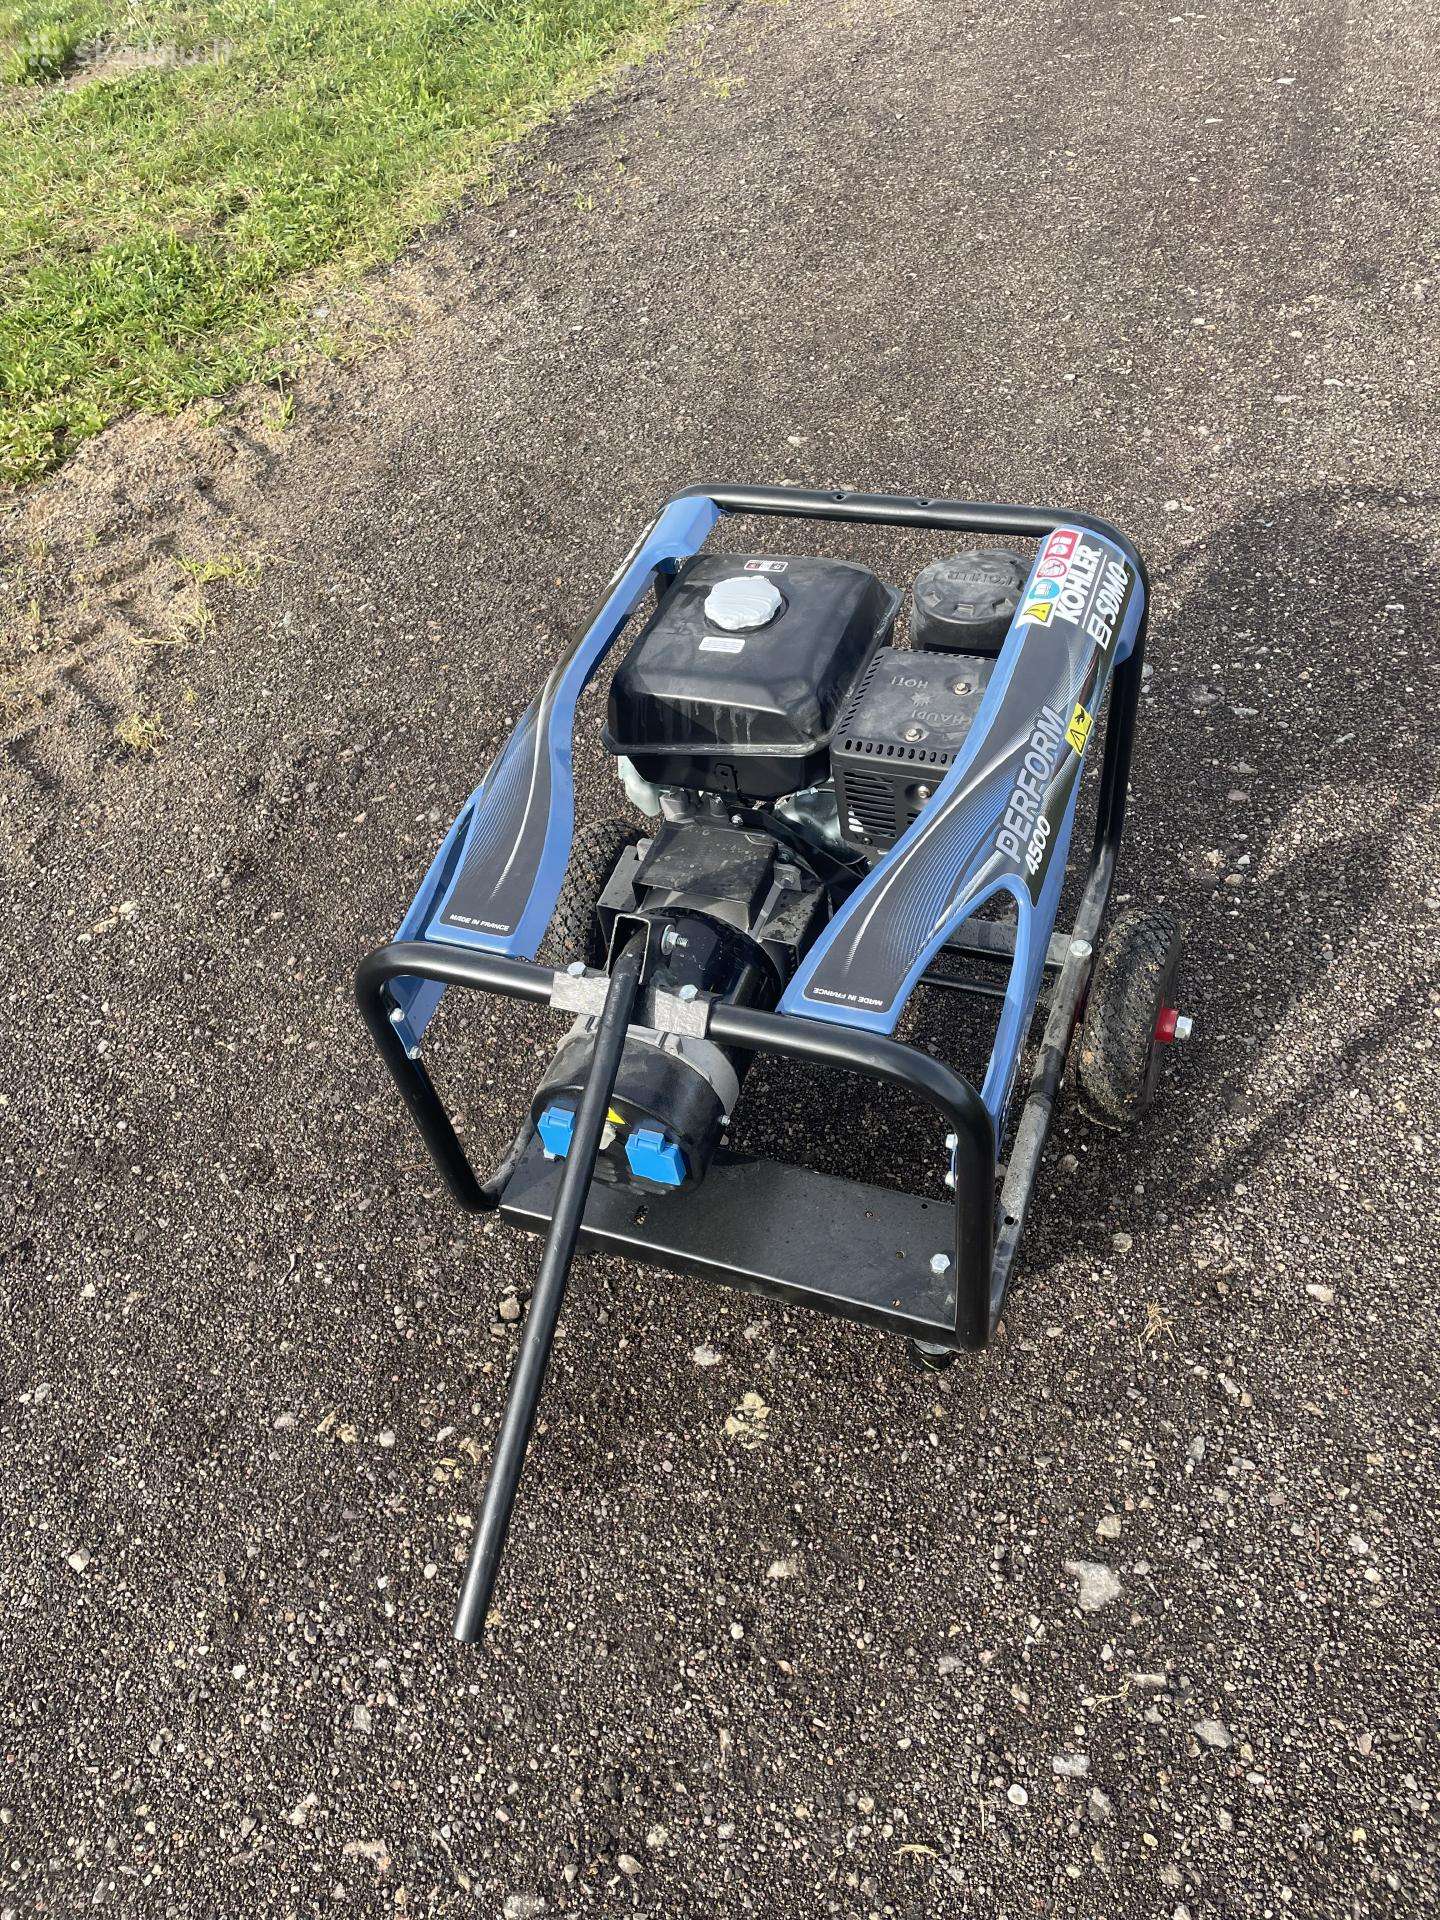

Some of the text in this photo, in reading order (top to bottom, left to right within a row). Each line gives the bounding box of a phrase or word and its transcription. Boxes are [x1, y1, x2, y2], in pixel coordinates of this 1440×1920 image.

[1055, 545, 1102, 625] KOHLER
[1096, 561, 1128, 625] SDMO
[996, 705, 1065, 863] PERFORM
[1024, 815, 1050, 875] 4500
[449, 913, 471, 924] MADE
[480, 920, 510, 932] FRANCE
[812, 987, 846, 999] FRANCE
[858, 996, 883, 1006] MADE
